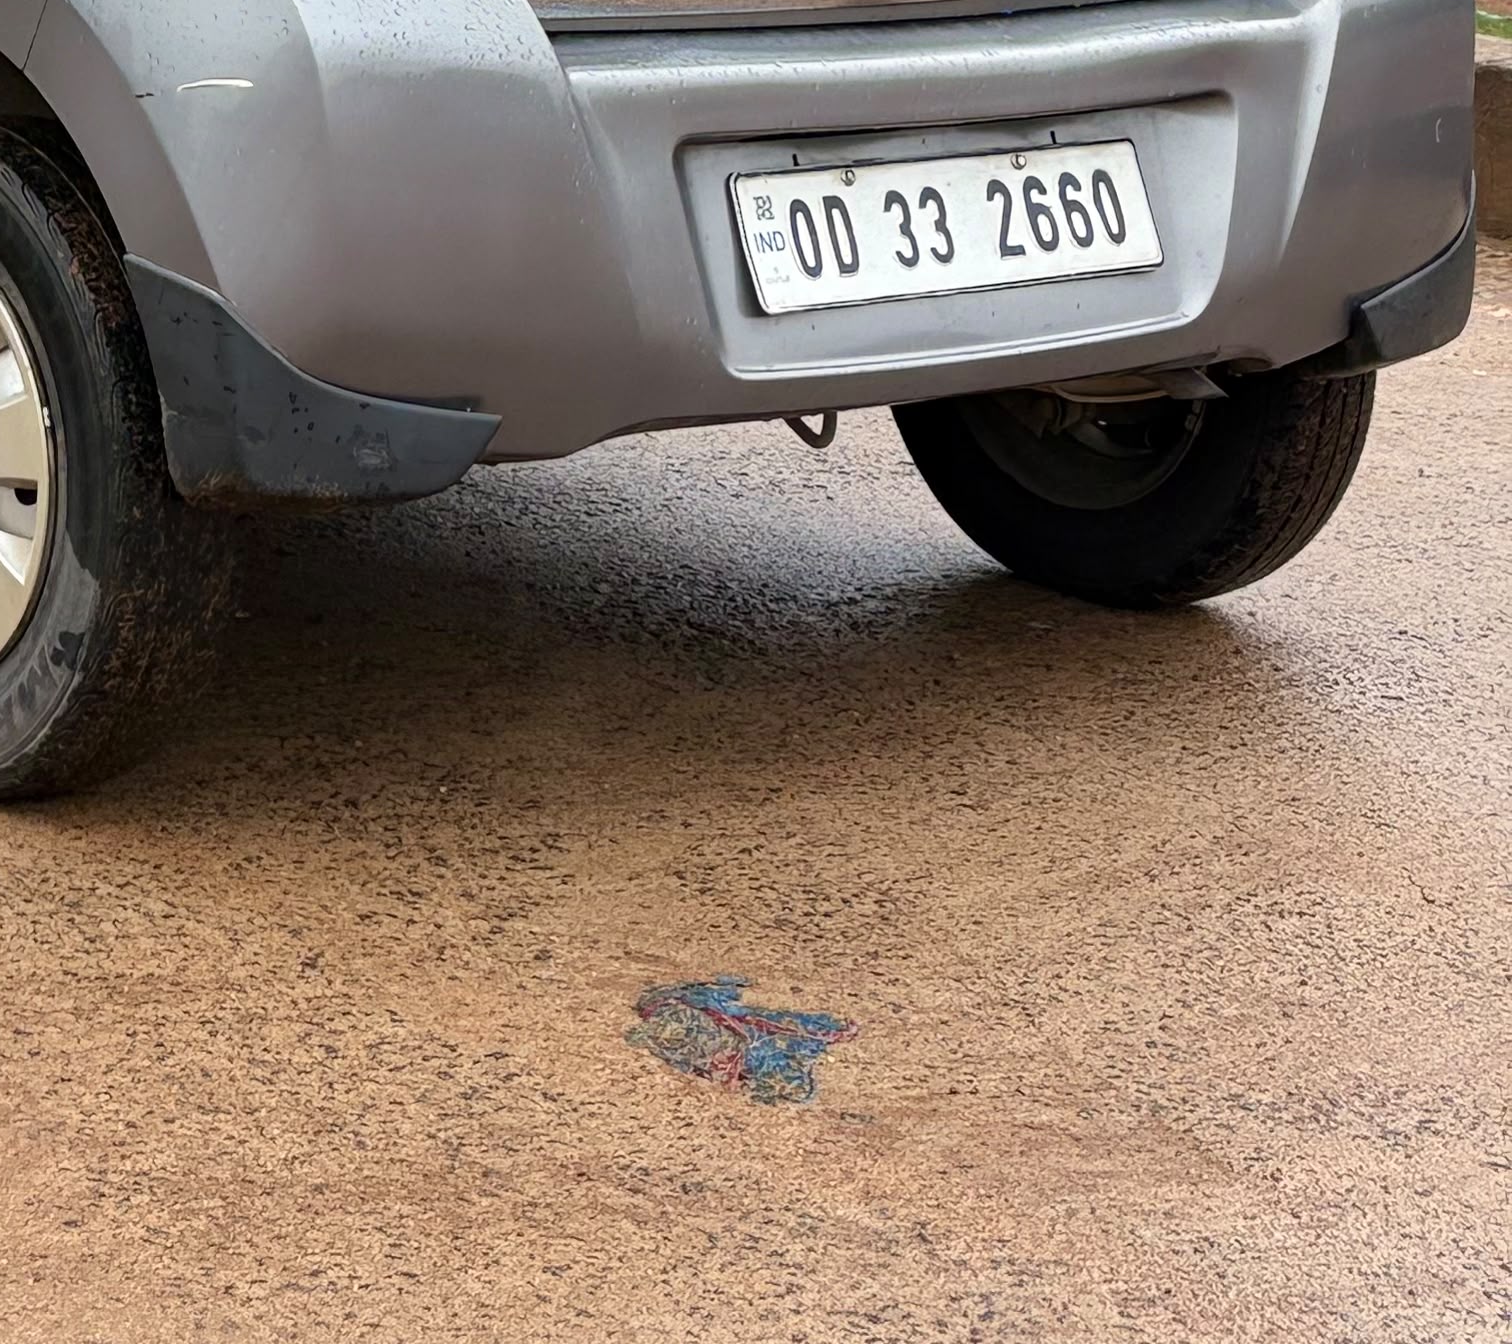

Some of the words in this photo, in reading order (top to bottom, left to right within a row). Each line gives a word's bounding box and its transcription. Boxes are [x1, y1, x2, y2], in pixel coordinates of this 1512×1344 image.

[753, 231, 786, 254] IND
[884, 187, 955, 268] 33
[987, 169, 1127, 260] 2660
